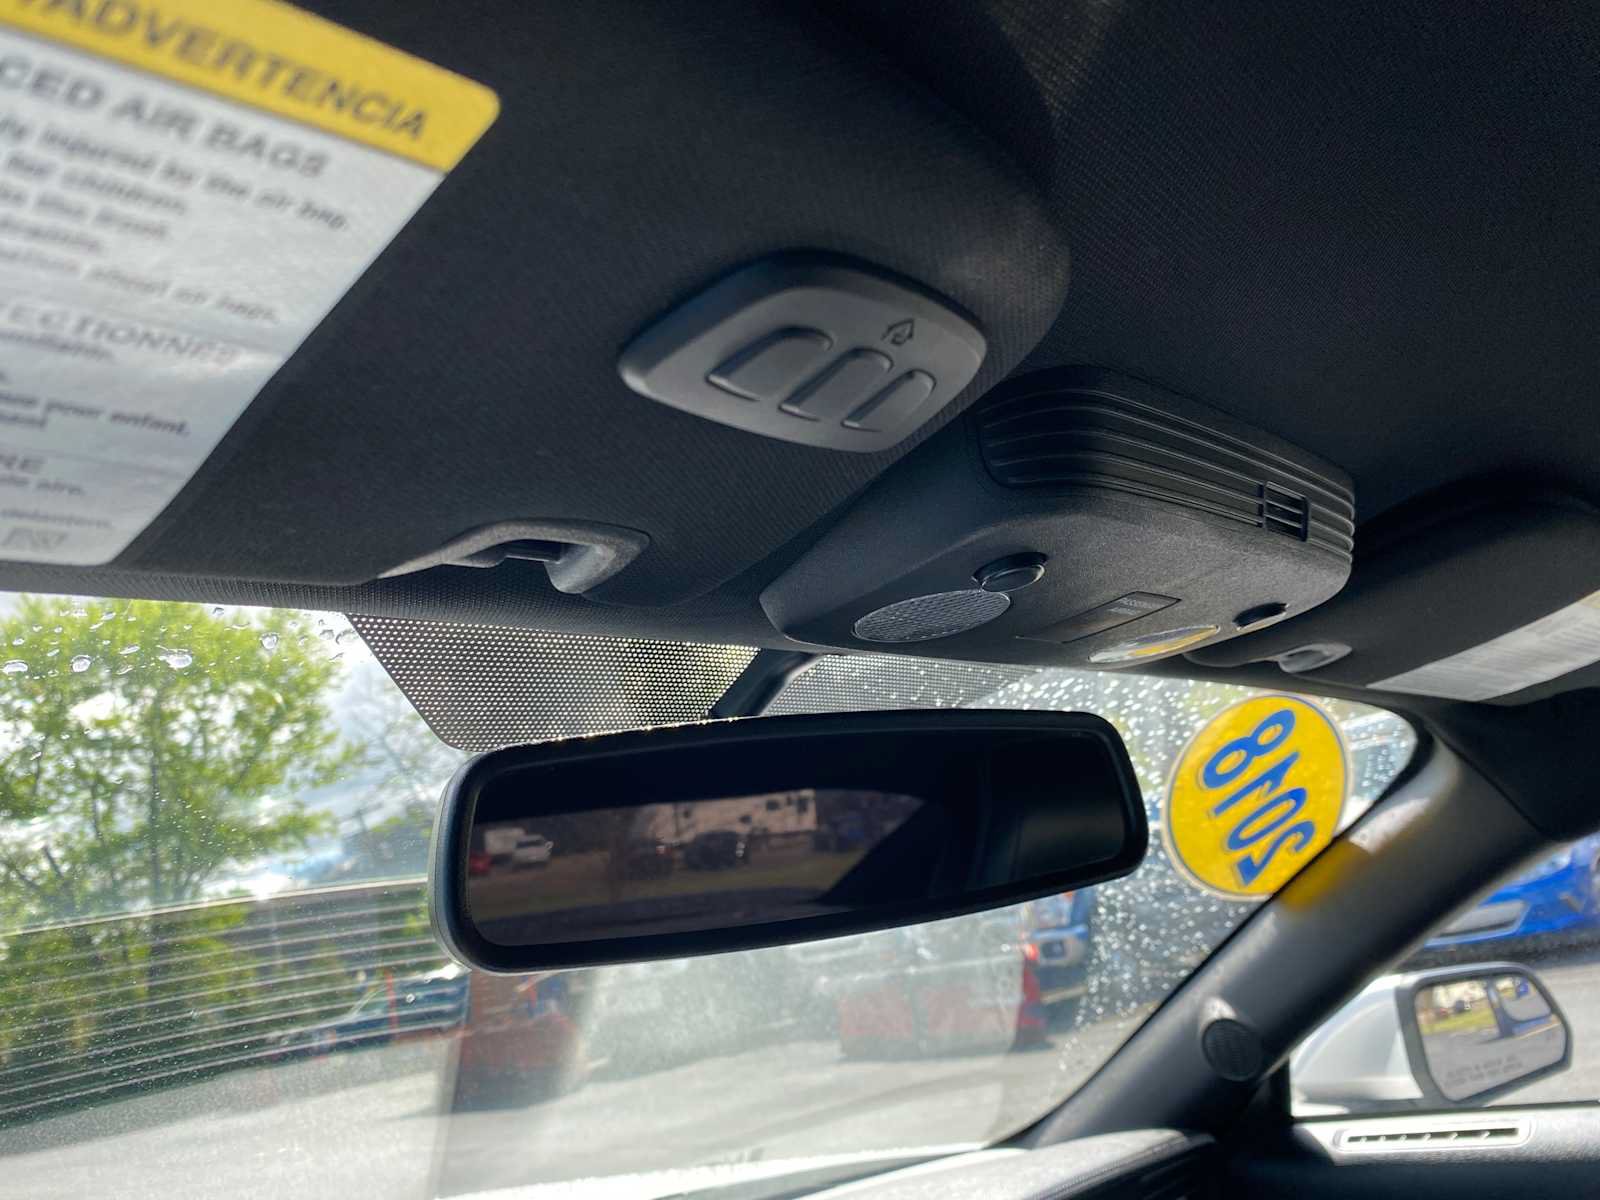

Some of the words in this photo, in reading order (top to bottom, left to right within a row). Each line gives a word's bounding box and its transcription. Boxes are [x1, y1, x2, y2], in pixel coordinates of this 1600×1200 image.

[43, 0, 428, 140] ADVERTENCIA
[110, 96, 201, 141] AIR
[205, 123, 329, 178] BAGS
